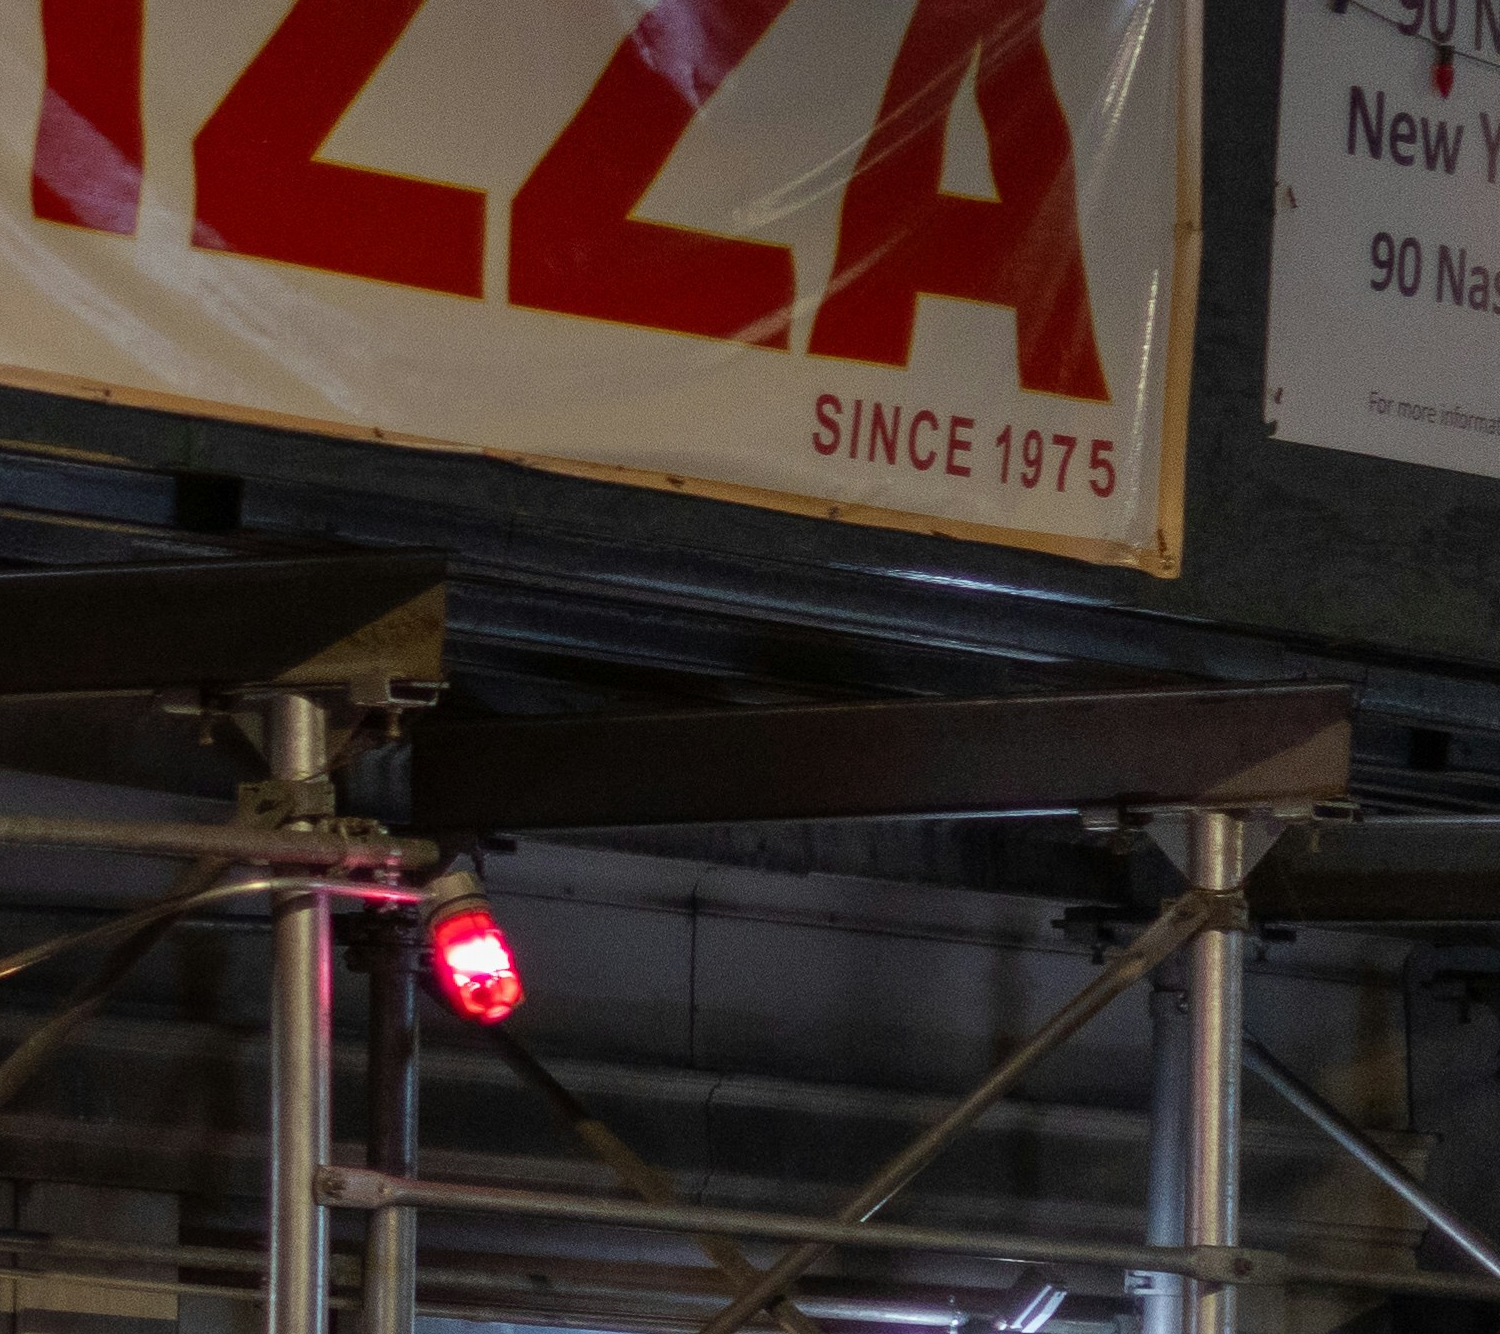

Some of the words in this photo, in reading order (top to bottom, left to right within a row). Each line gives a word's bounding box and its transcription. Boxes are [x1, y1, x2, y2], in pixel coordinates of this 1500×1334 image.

[1347, 85, 1464, 176] New
[1370, 231, 1422, 299] 90
[812, 389, 976, 478] SINCE
[995, 424, 1116, 498] 1975
[1368, 391, 1395, 417] For
[1398, 399, 1437, 426] more
